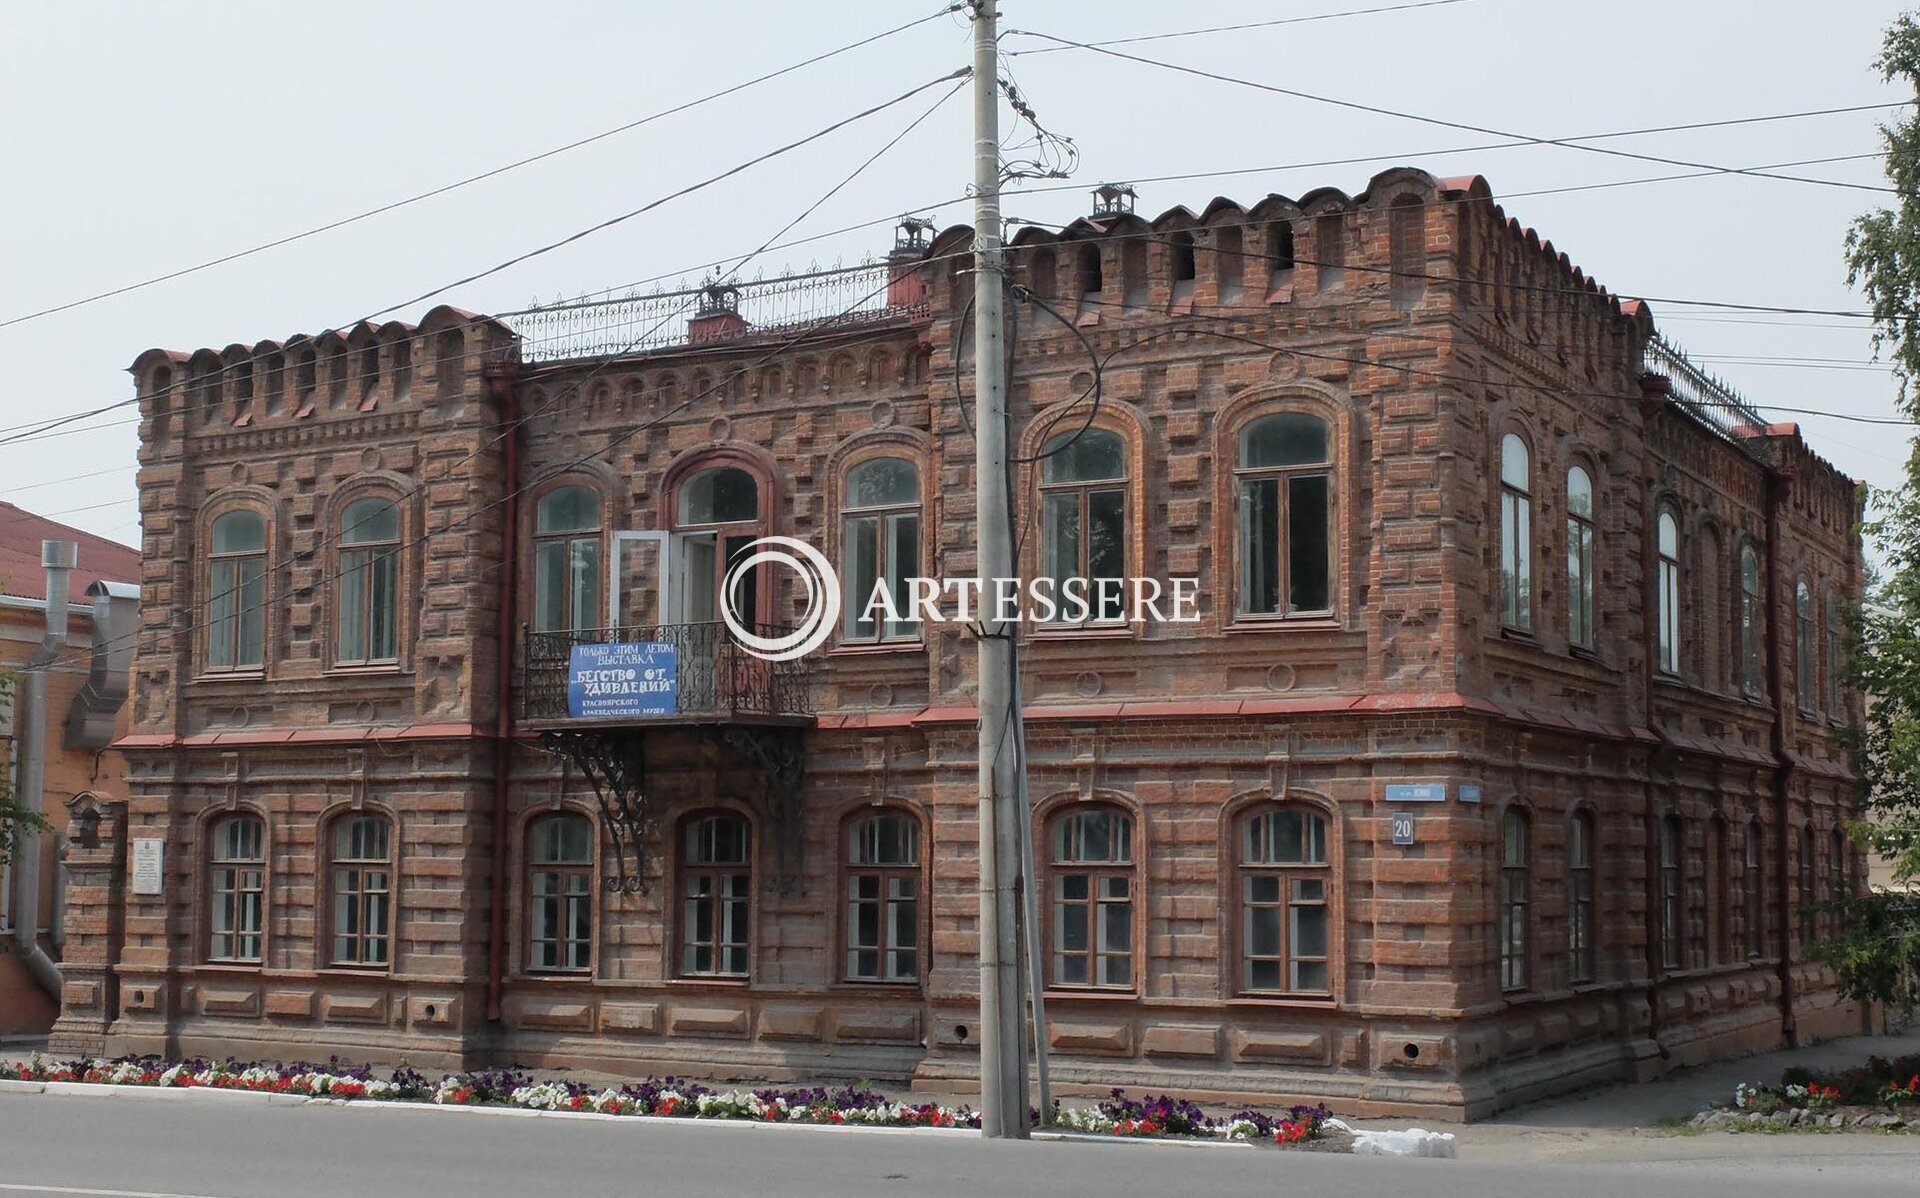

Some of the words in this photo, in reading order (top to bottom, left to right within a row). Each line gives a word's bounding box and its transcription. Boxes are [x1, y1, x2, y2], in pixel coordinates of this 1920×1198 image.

[580, 646, 609, 657] ТОЛЬКО
[614, 645, 639, 655] ЭТИМ
[645, 643, 674, 654] ЛЕТОМ
[597, 654, 654, 666] ВЫСТАВКА
[644, 668, 666, 681] ОТ
[1395, 820, 1411, 837] 20
